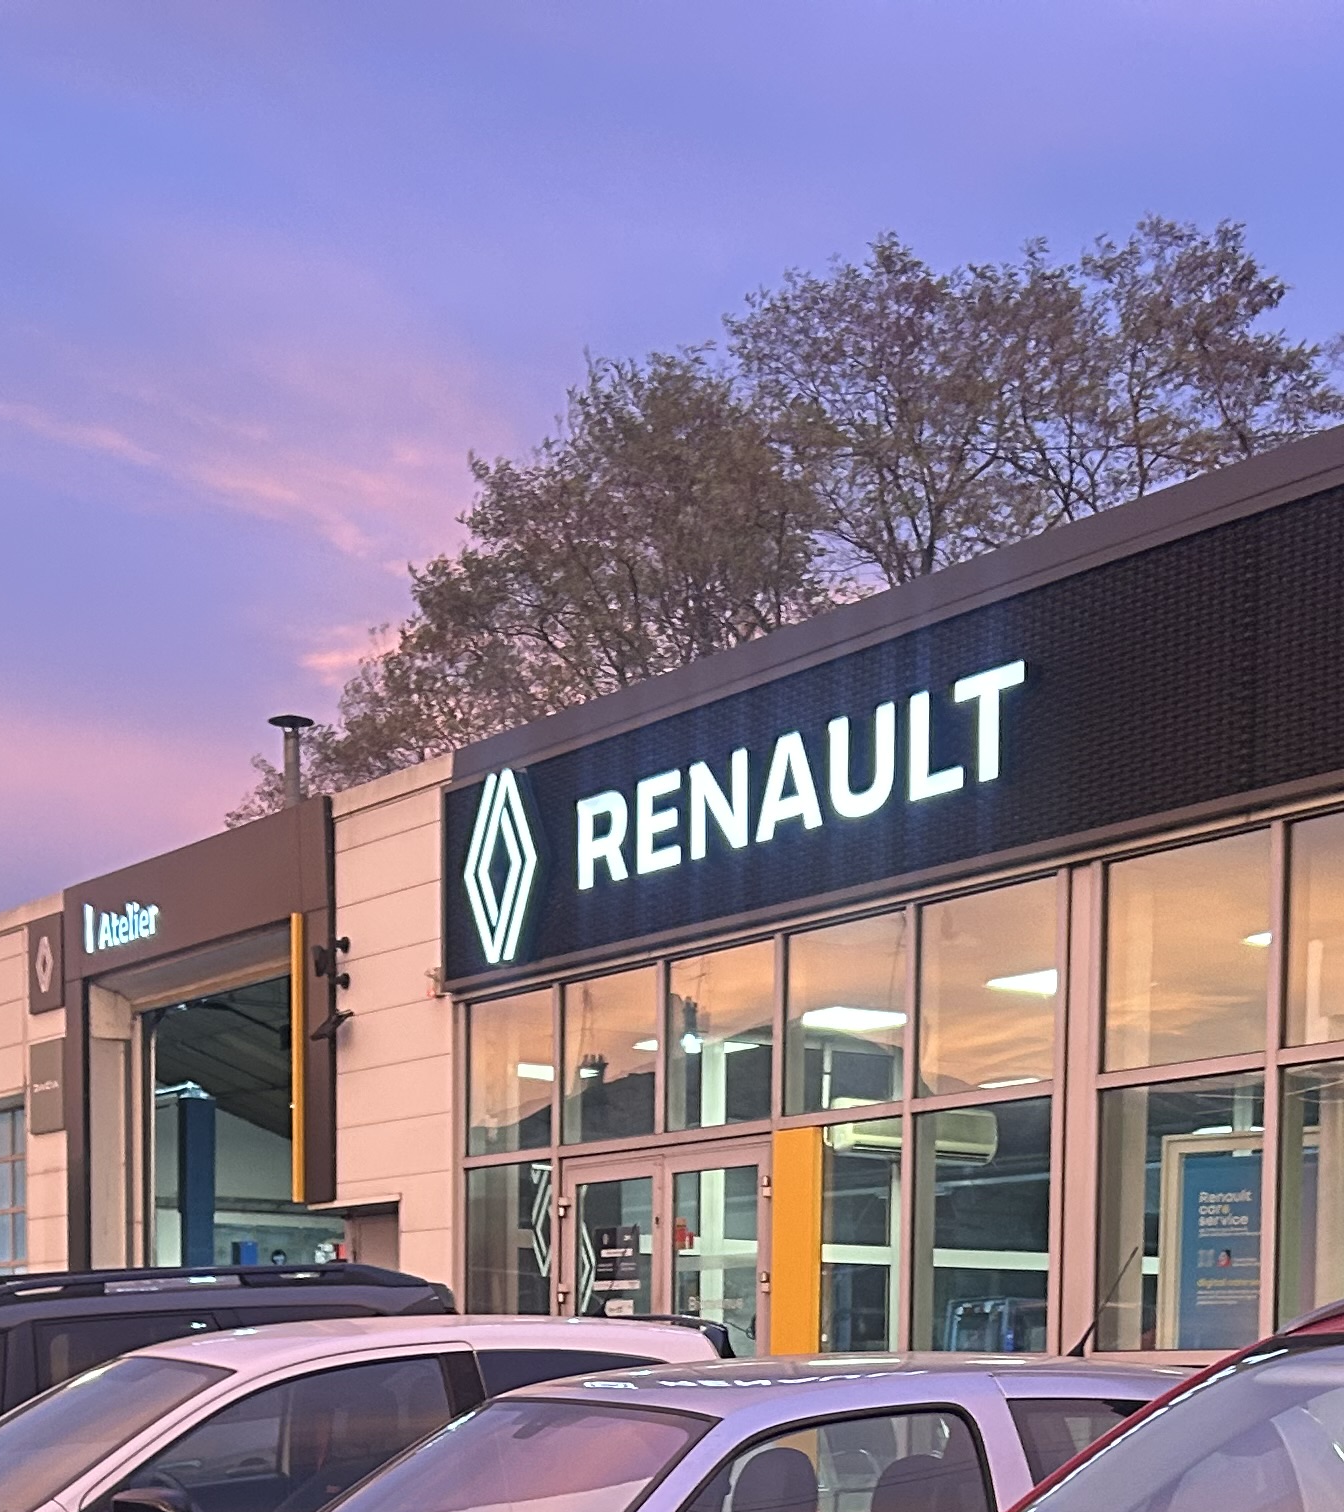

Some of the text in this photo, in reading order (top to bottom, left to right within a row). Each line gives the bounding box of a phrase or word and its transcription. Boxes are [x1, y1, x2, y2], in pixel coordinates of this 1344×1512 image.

[577, 659, 1026, 890] RENAULT
[98, 901, 159, 950] Atelier
[1198, 1189, 1253, 1203] Renault
[1198, 1213, 1249, 1226] service
